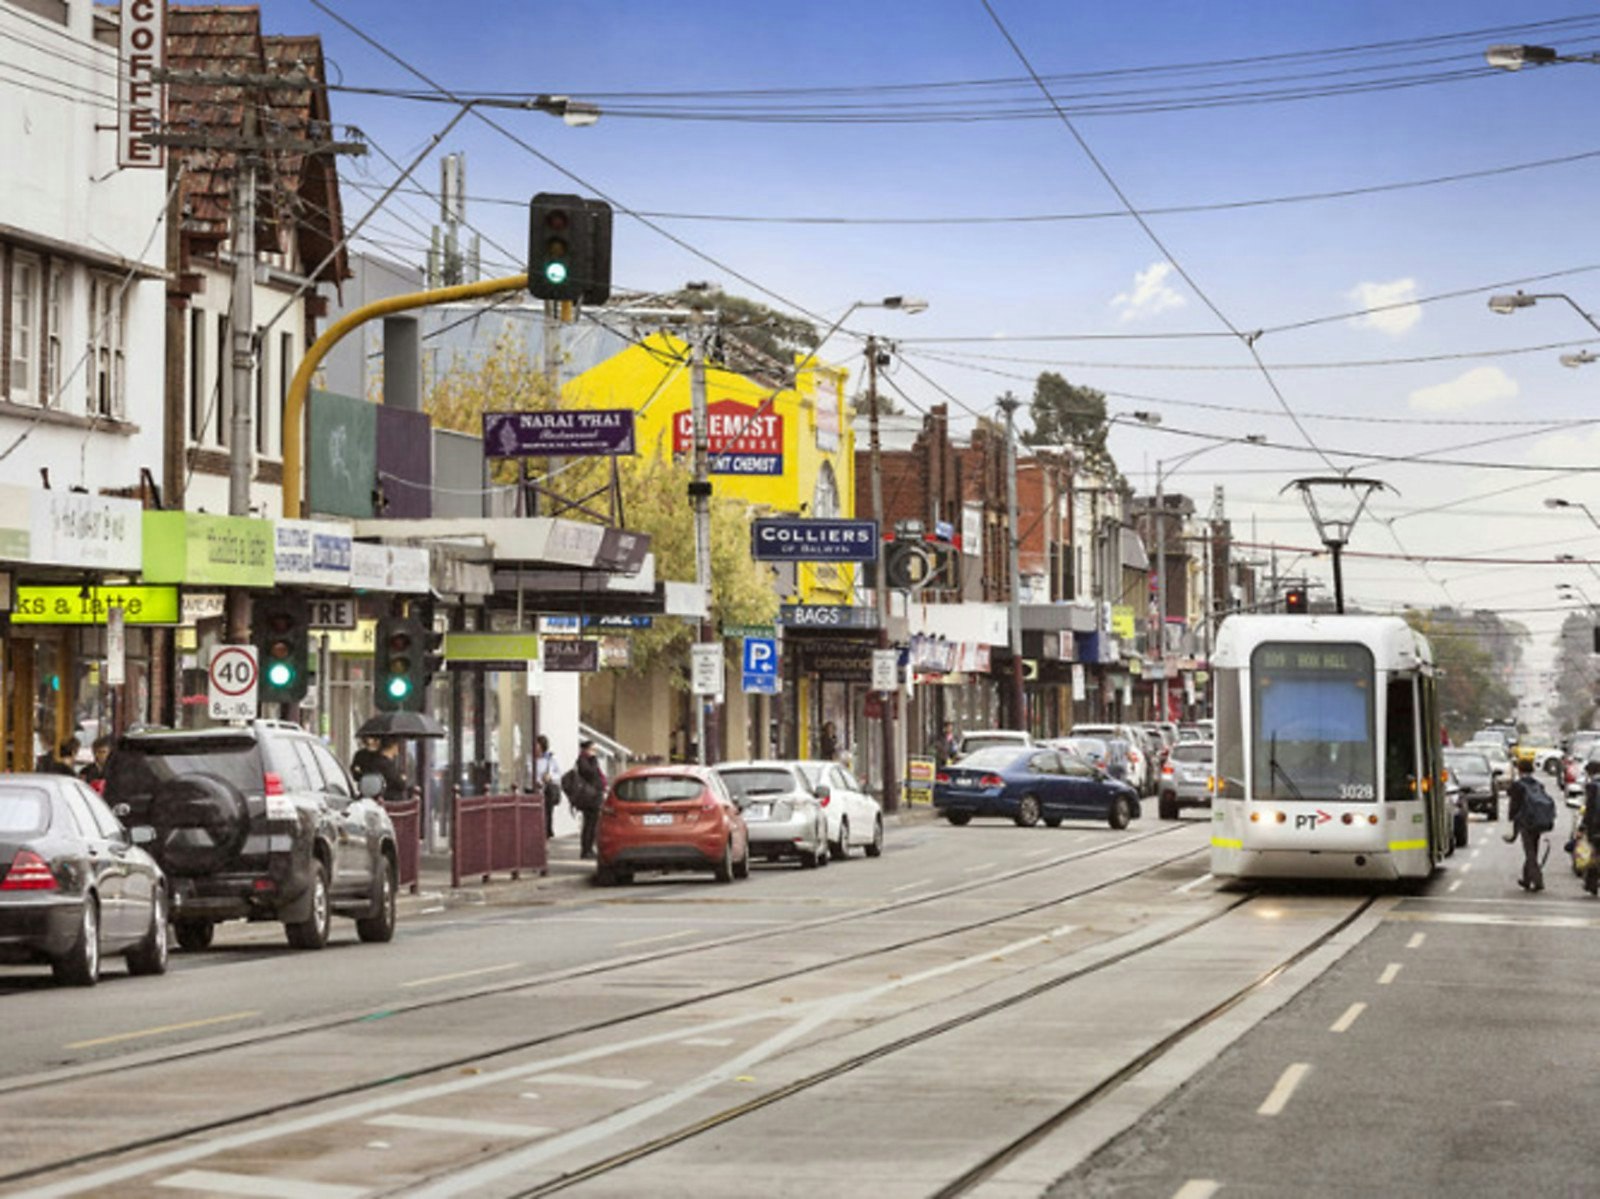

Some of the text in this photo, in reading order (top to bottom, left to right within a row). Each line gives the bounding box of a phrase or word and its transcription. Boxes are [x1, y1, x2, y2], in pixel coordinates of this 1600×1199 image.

[129, 0, 154, 160] COFFEE
[521, 414, 620, 427] NARAI THAI
[680, 414, 778, 437] CEMIST
[732, 457, 777, 473] CHEMIST
[761, 527, 869, 542] COLLIERS
[54, 598, 70, 615] a
[81, 595, 142, 615] latte
[795, 607, 839, 624] BAGS
[750, 643, 771, 670] P
[218, 661, 251, 684] 40
[1340, 784, 1374, 799] 3028
